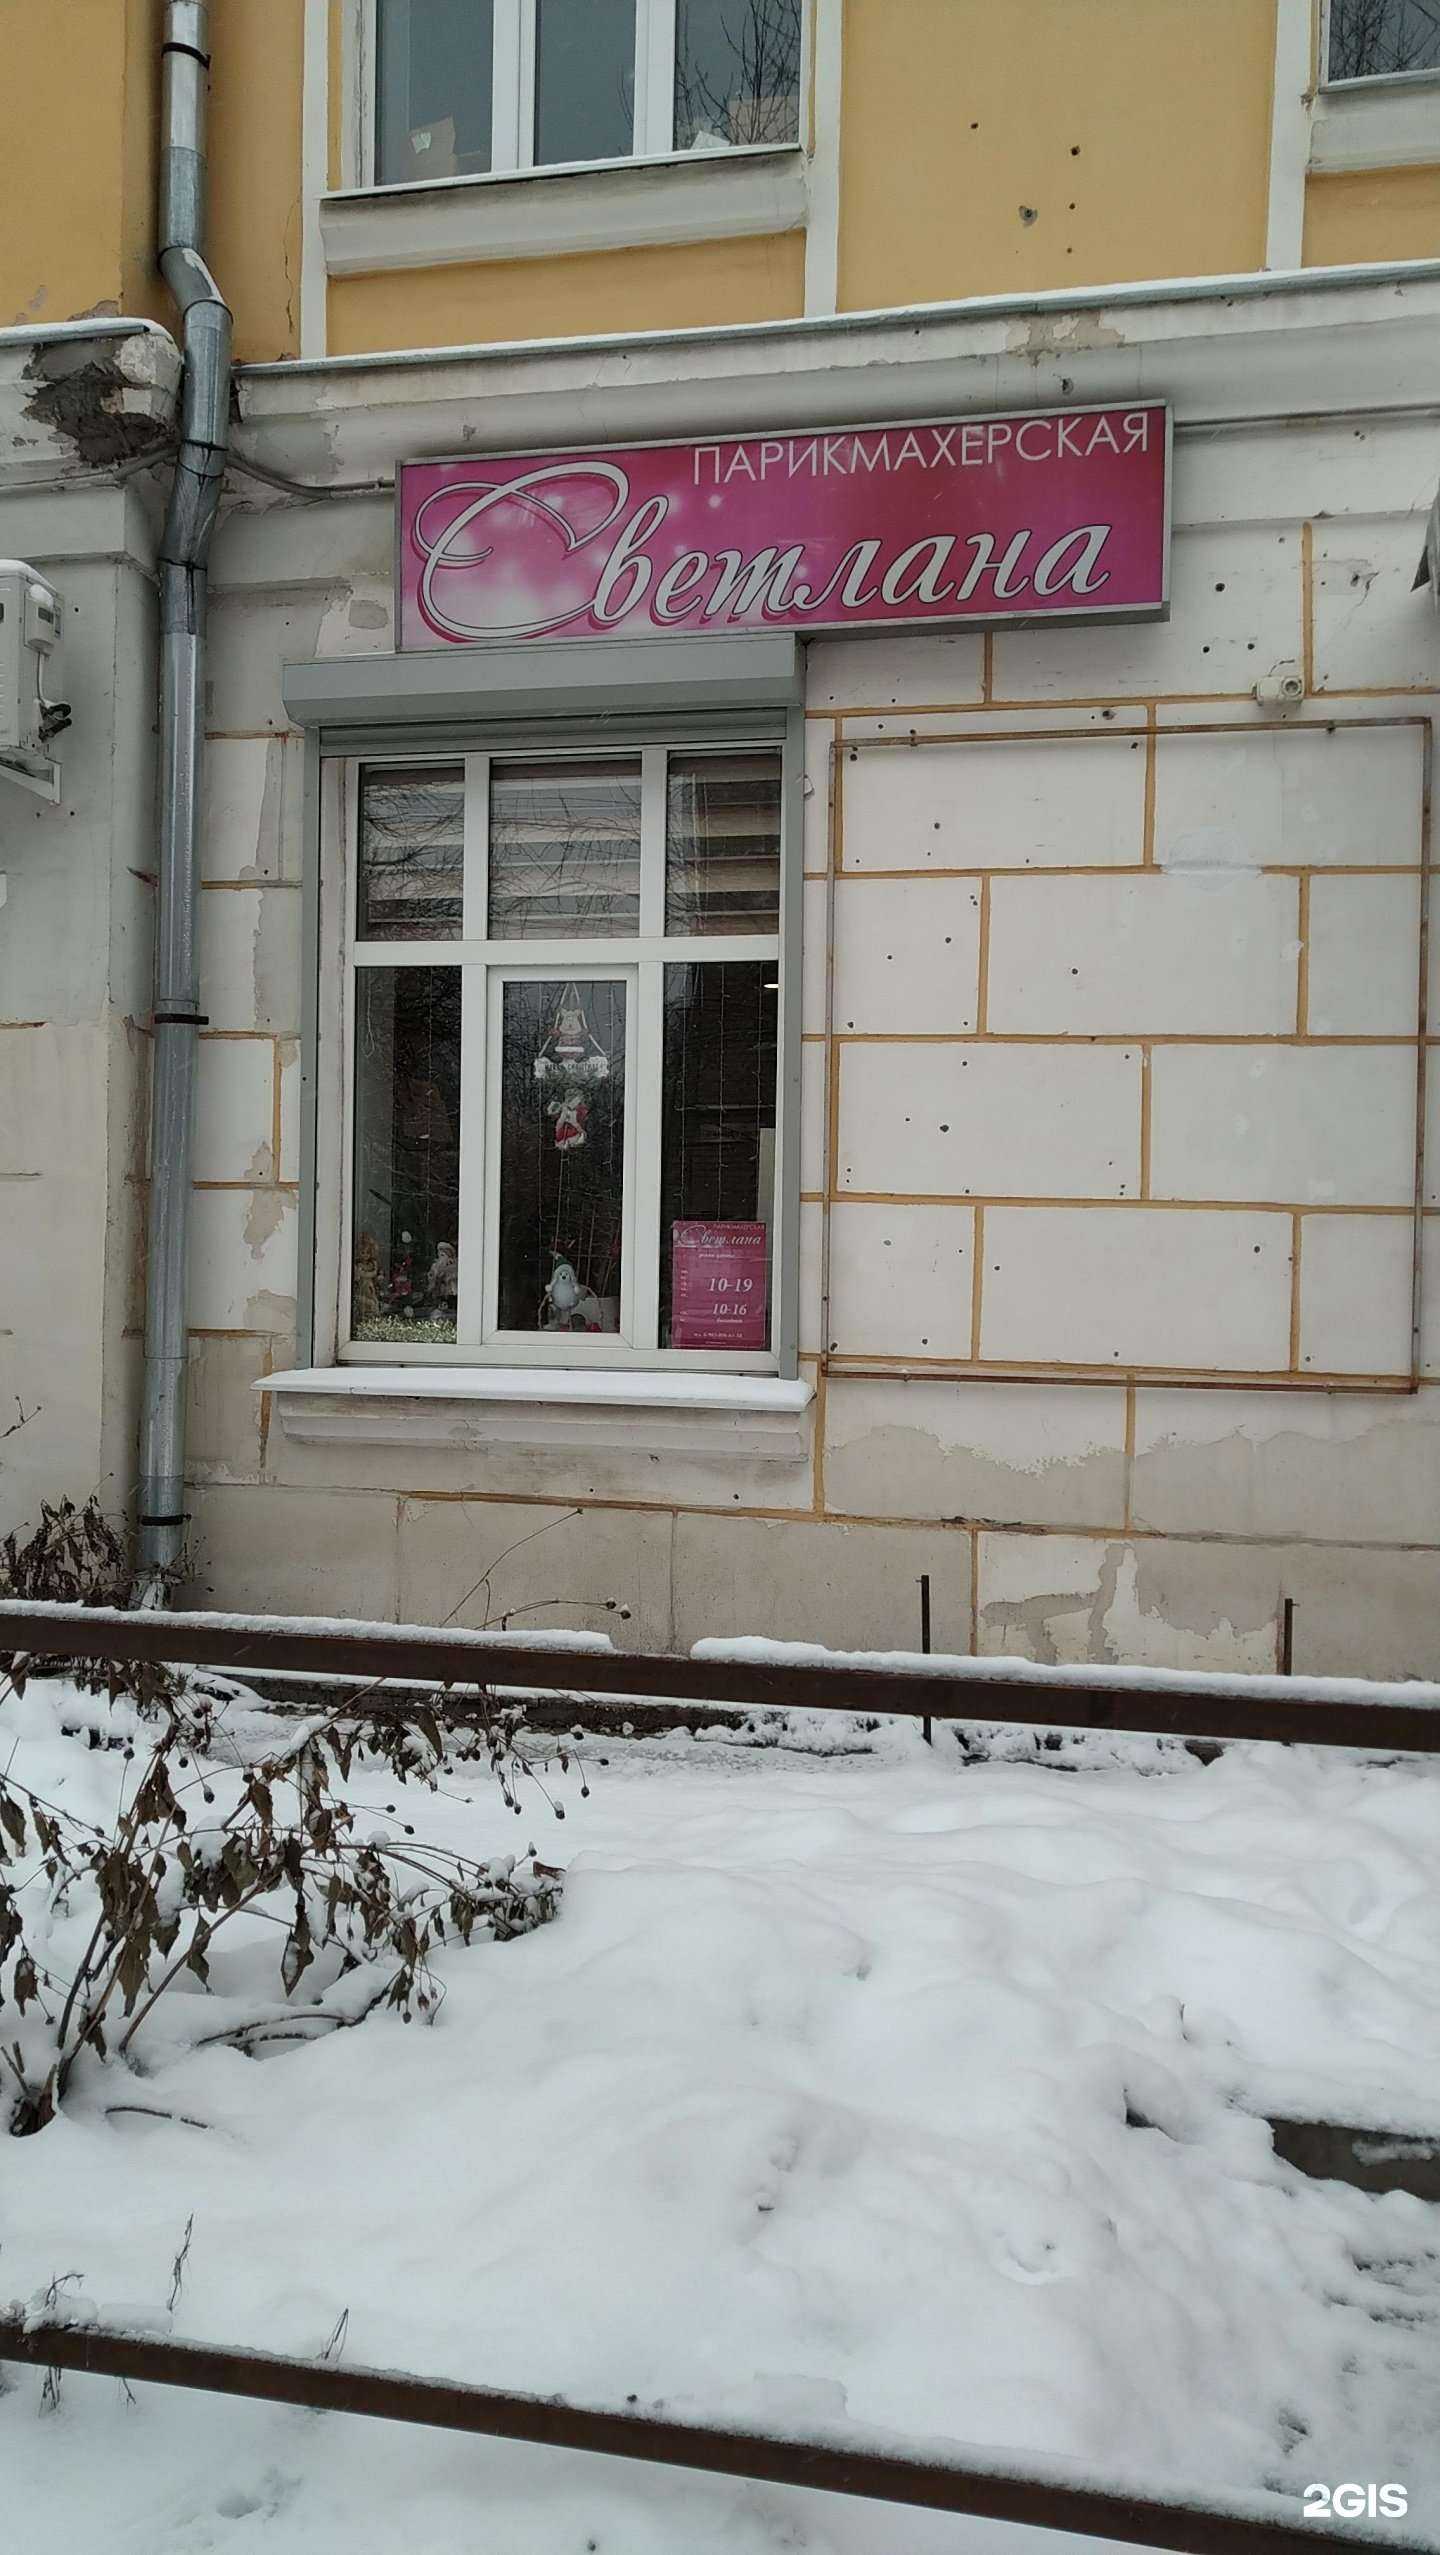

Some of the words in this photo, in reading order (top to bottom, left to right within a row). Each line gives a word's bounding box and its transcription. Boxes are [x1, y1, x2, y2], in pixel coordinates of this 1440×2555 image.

[693, 411, 1150, 486] ПАРИКМАХЕРСКАЯ
[413, 460, 1112, 641] Светлана
[709, 1279, 753, 1293] 10-19
[713, 1303, 748, 1315] 10-16
